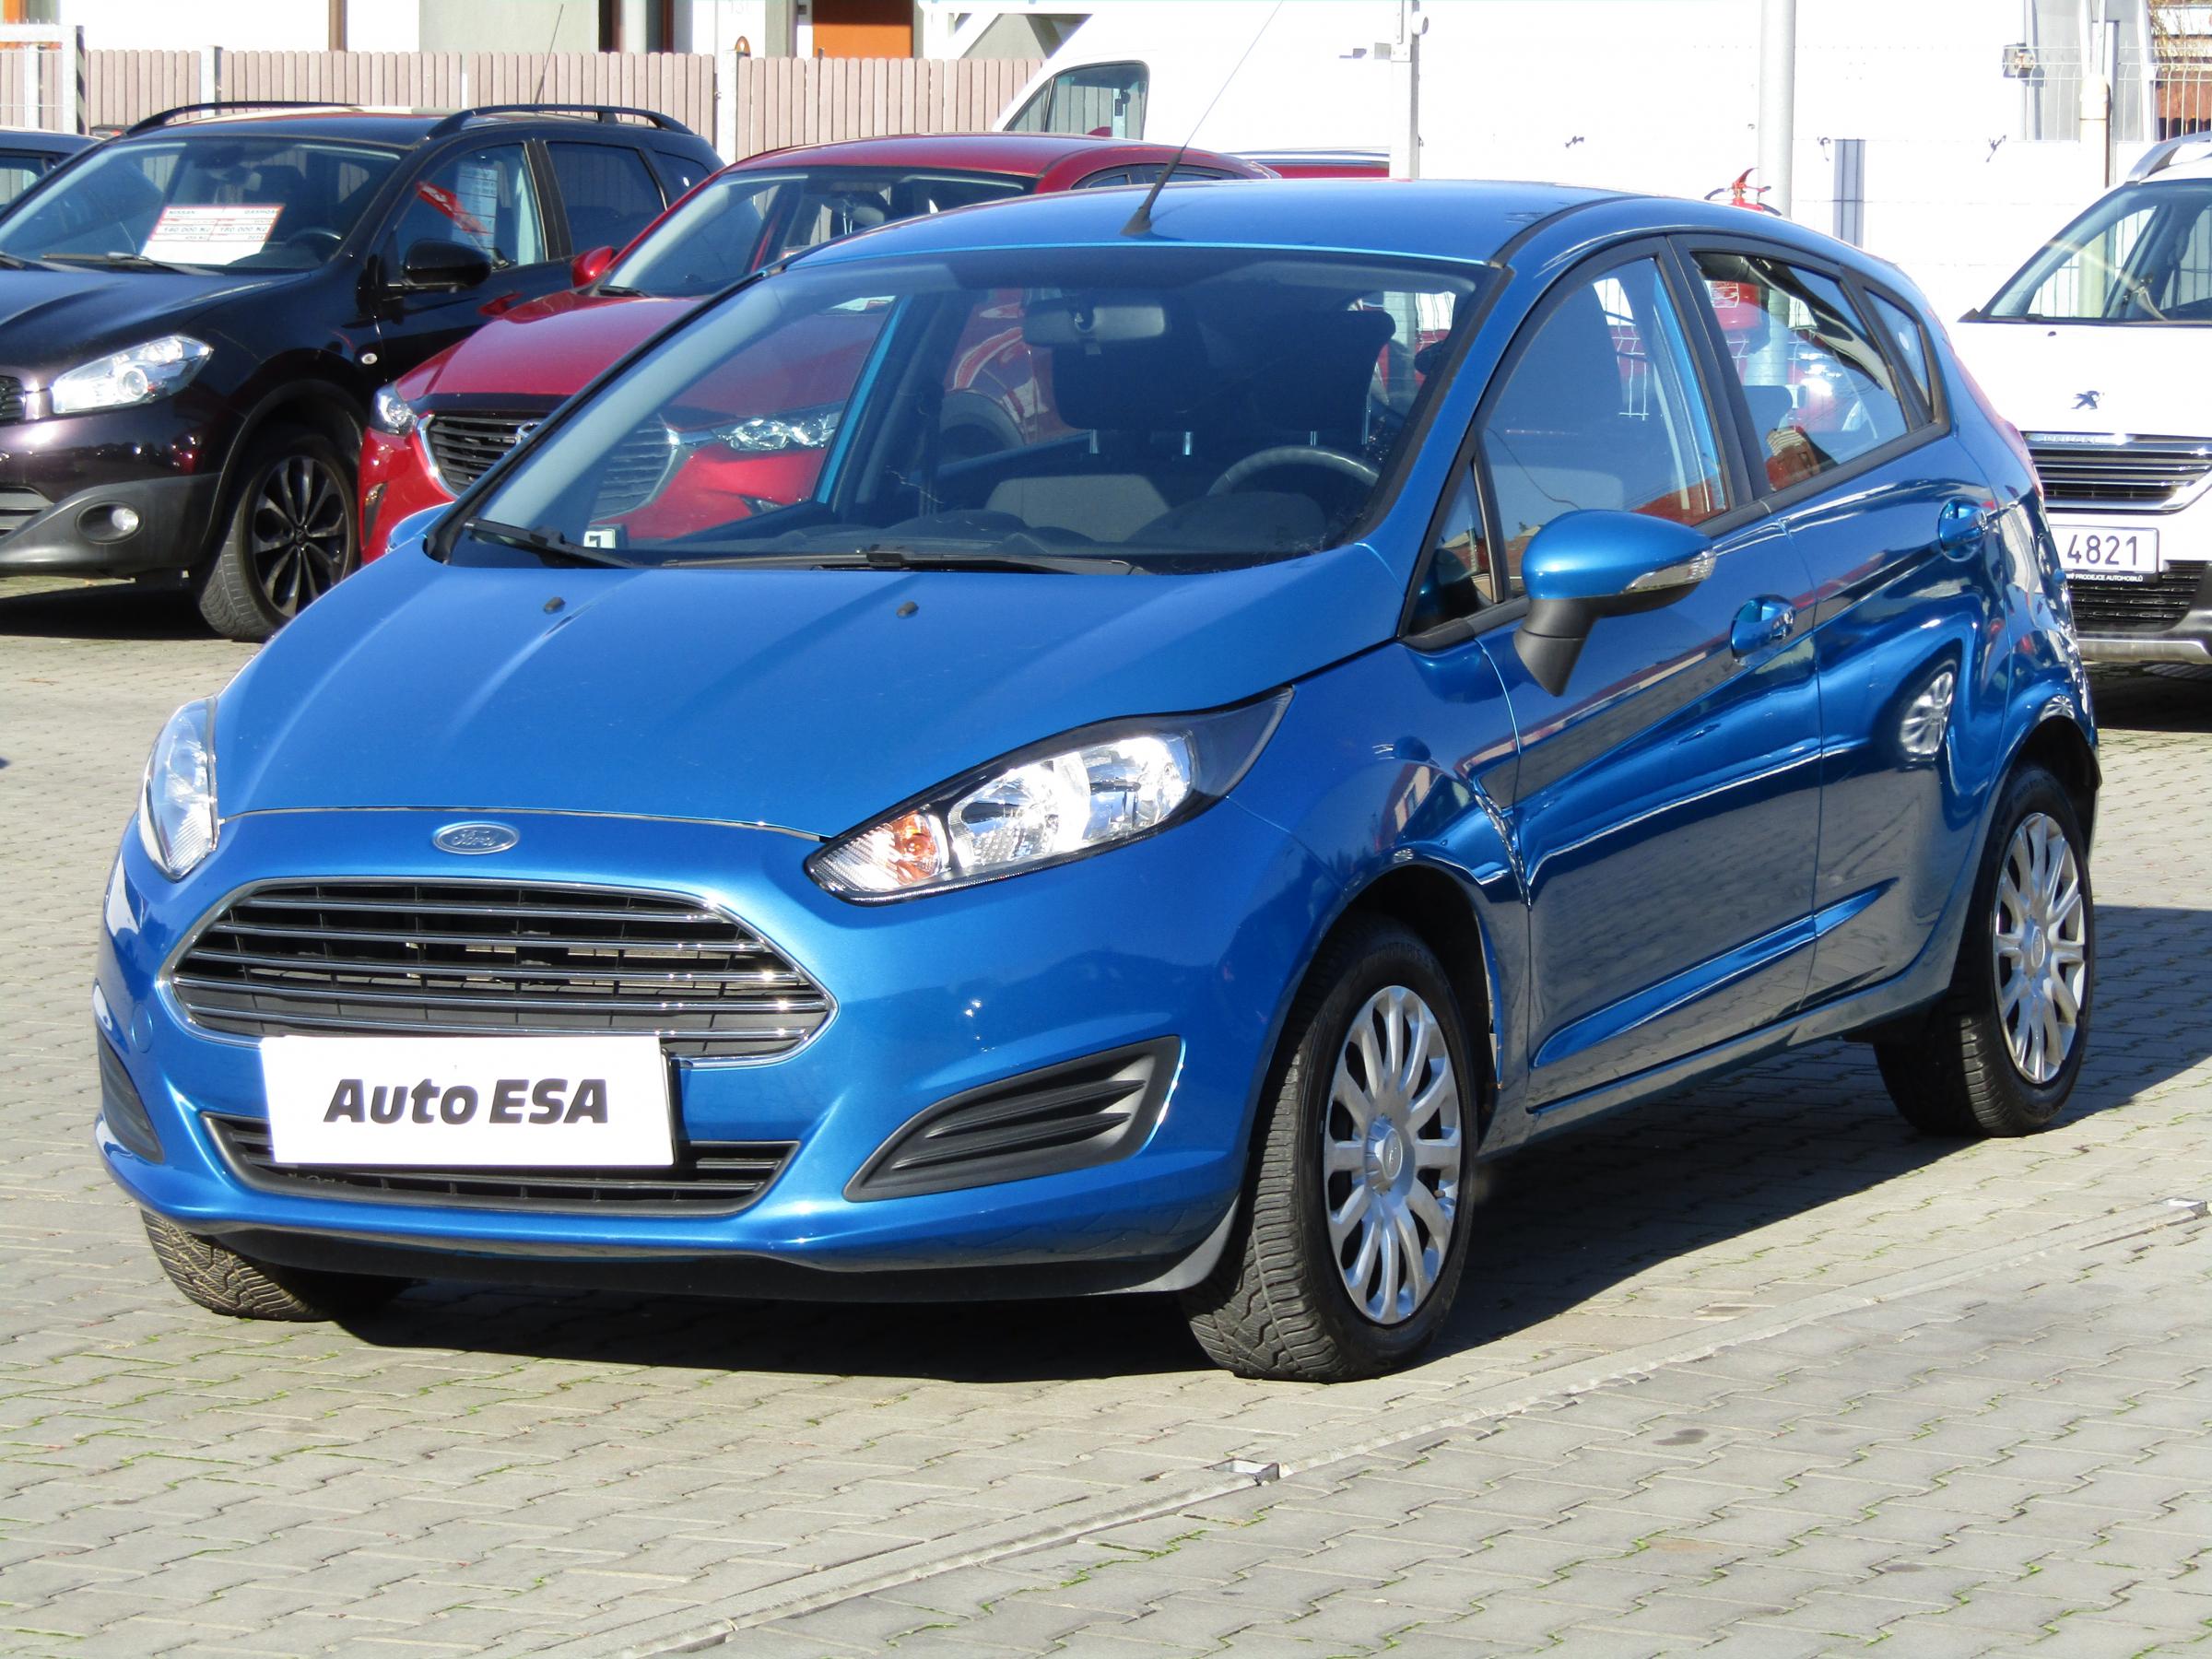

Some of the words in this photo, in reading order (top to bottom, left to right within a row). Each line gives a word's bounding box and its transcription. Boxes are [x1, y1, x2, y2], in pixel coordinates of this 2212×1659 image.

[2067, 535, 2137, 566] 4821
[2075, 573, 2106, 582] PRODEJCE
[324, 1078, 478, 1124] Auto
[489, 1078, 608, 1124] ESA
